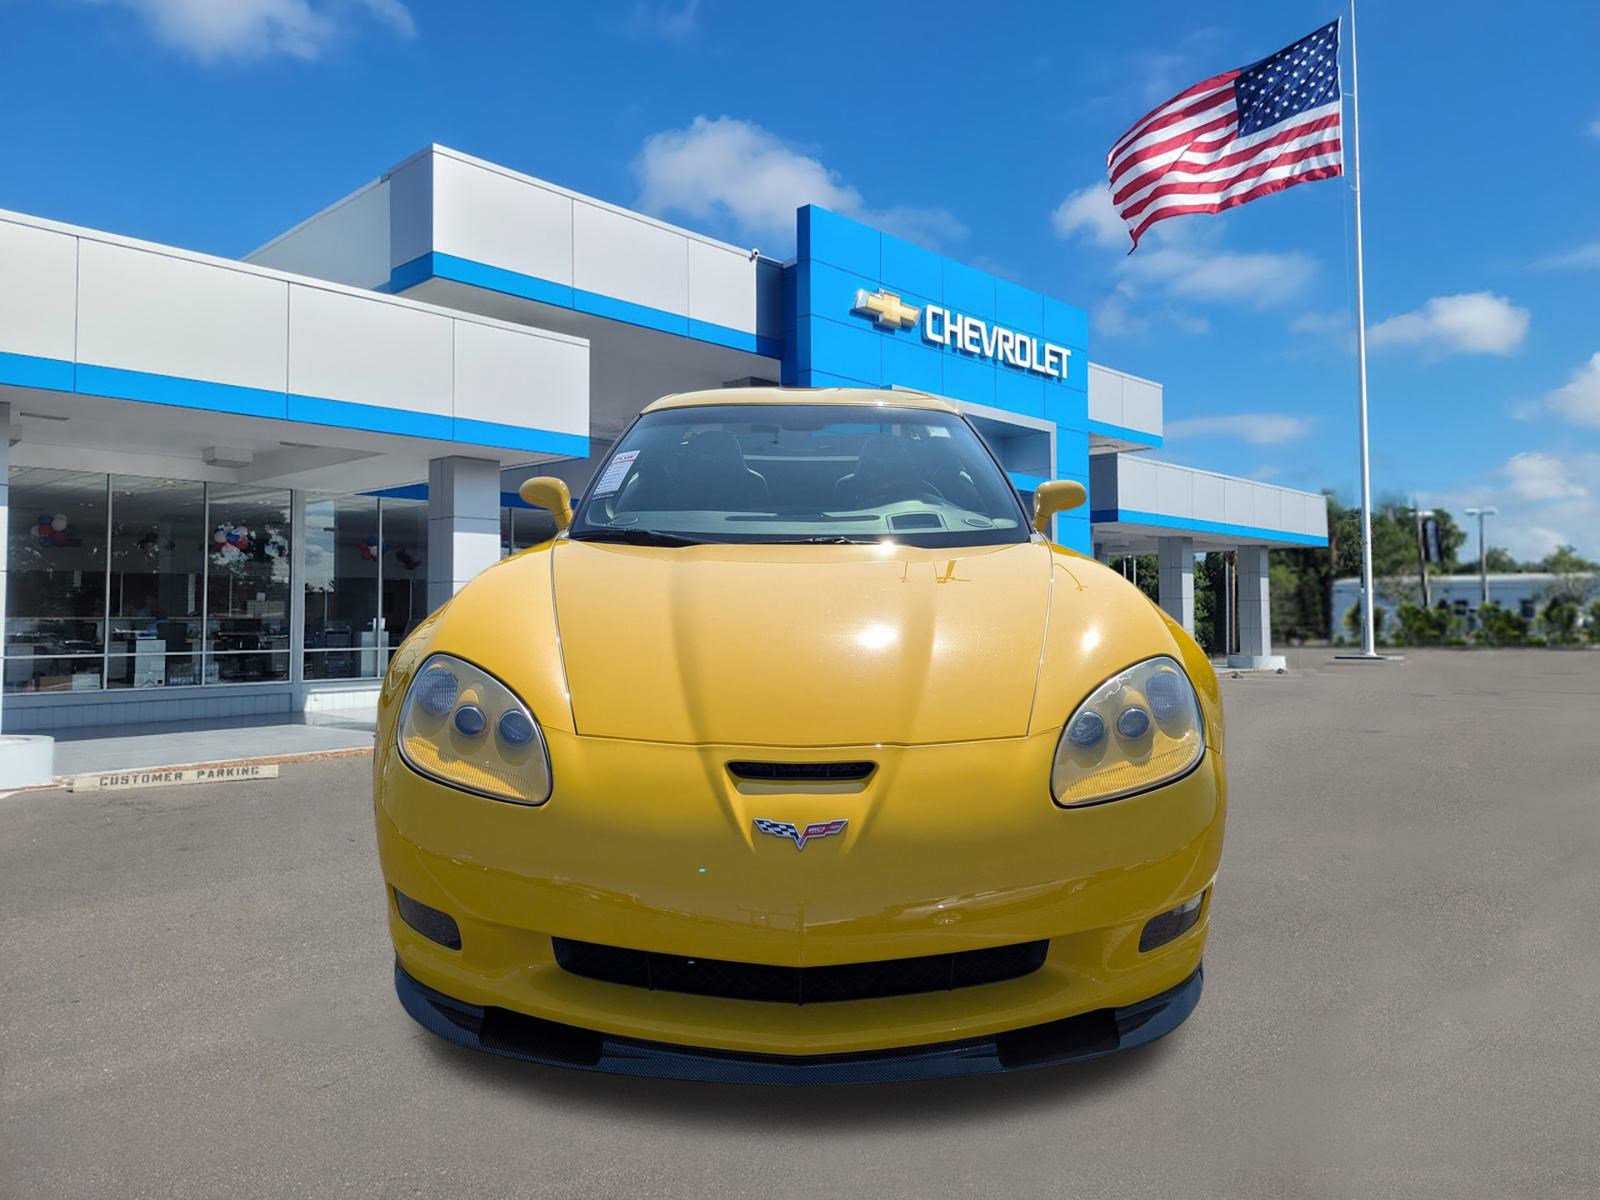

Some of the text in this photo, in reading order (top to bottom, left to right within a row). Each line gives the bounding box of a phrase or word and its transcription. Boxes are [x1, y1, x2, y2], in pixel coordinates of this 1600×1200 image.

[925, 303, 1072, 380] CHEVROLET
[99, 766, 260, 787] CUSTOMER PARKING
